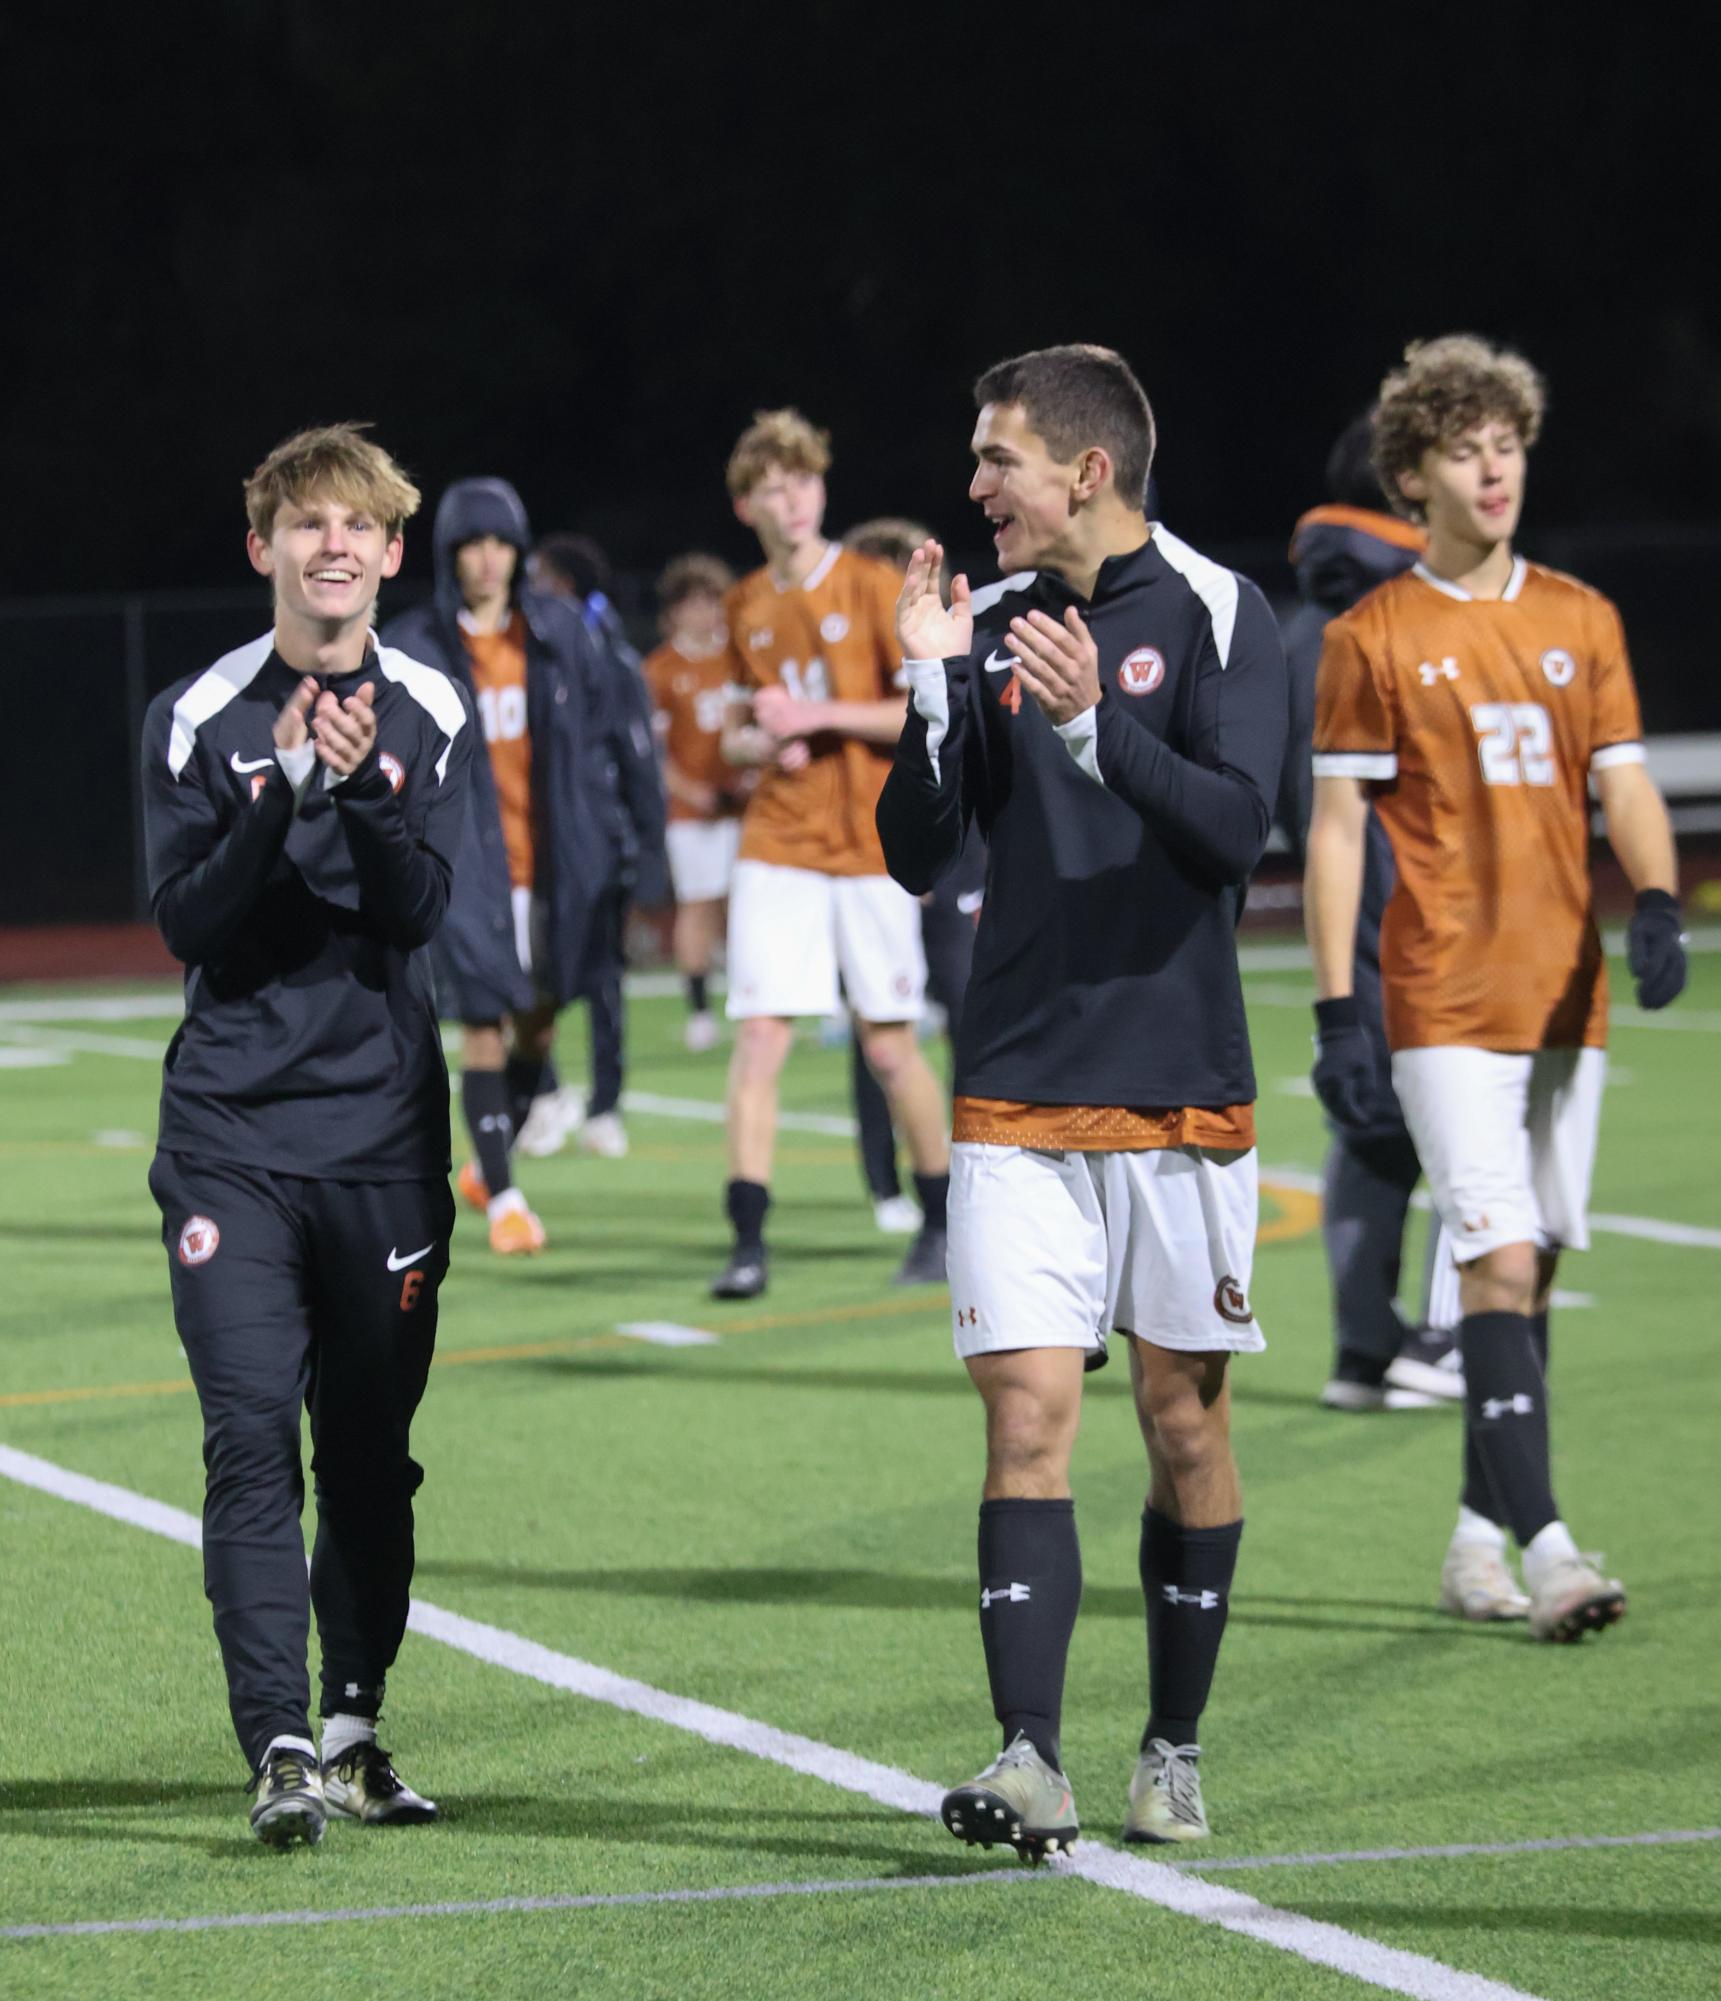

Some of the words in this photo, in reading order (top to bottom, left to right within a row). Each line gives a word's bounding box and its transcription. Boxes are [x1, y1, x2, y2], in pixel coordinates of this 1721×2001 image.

[1129, 660, 1154, 682] W
[477, 686, 527, 742] 10
[999, 672, 1022, 715] 4
[1469, 704, 1555, 787] 22
[186, 1230, 206, 1253] W
[400, 1270, 424, 1312] 6
